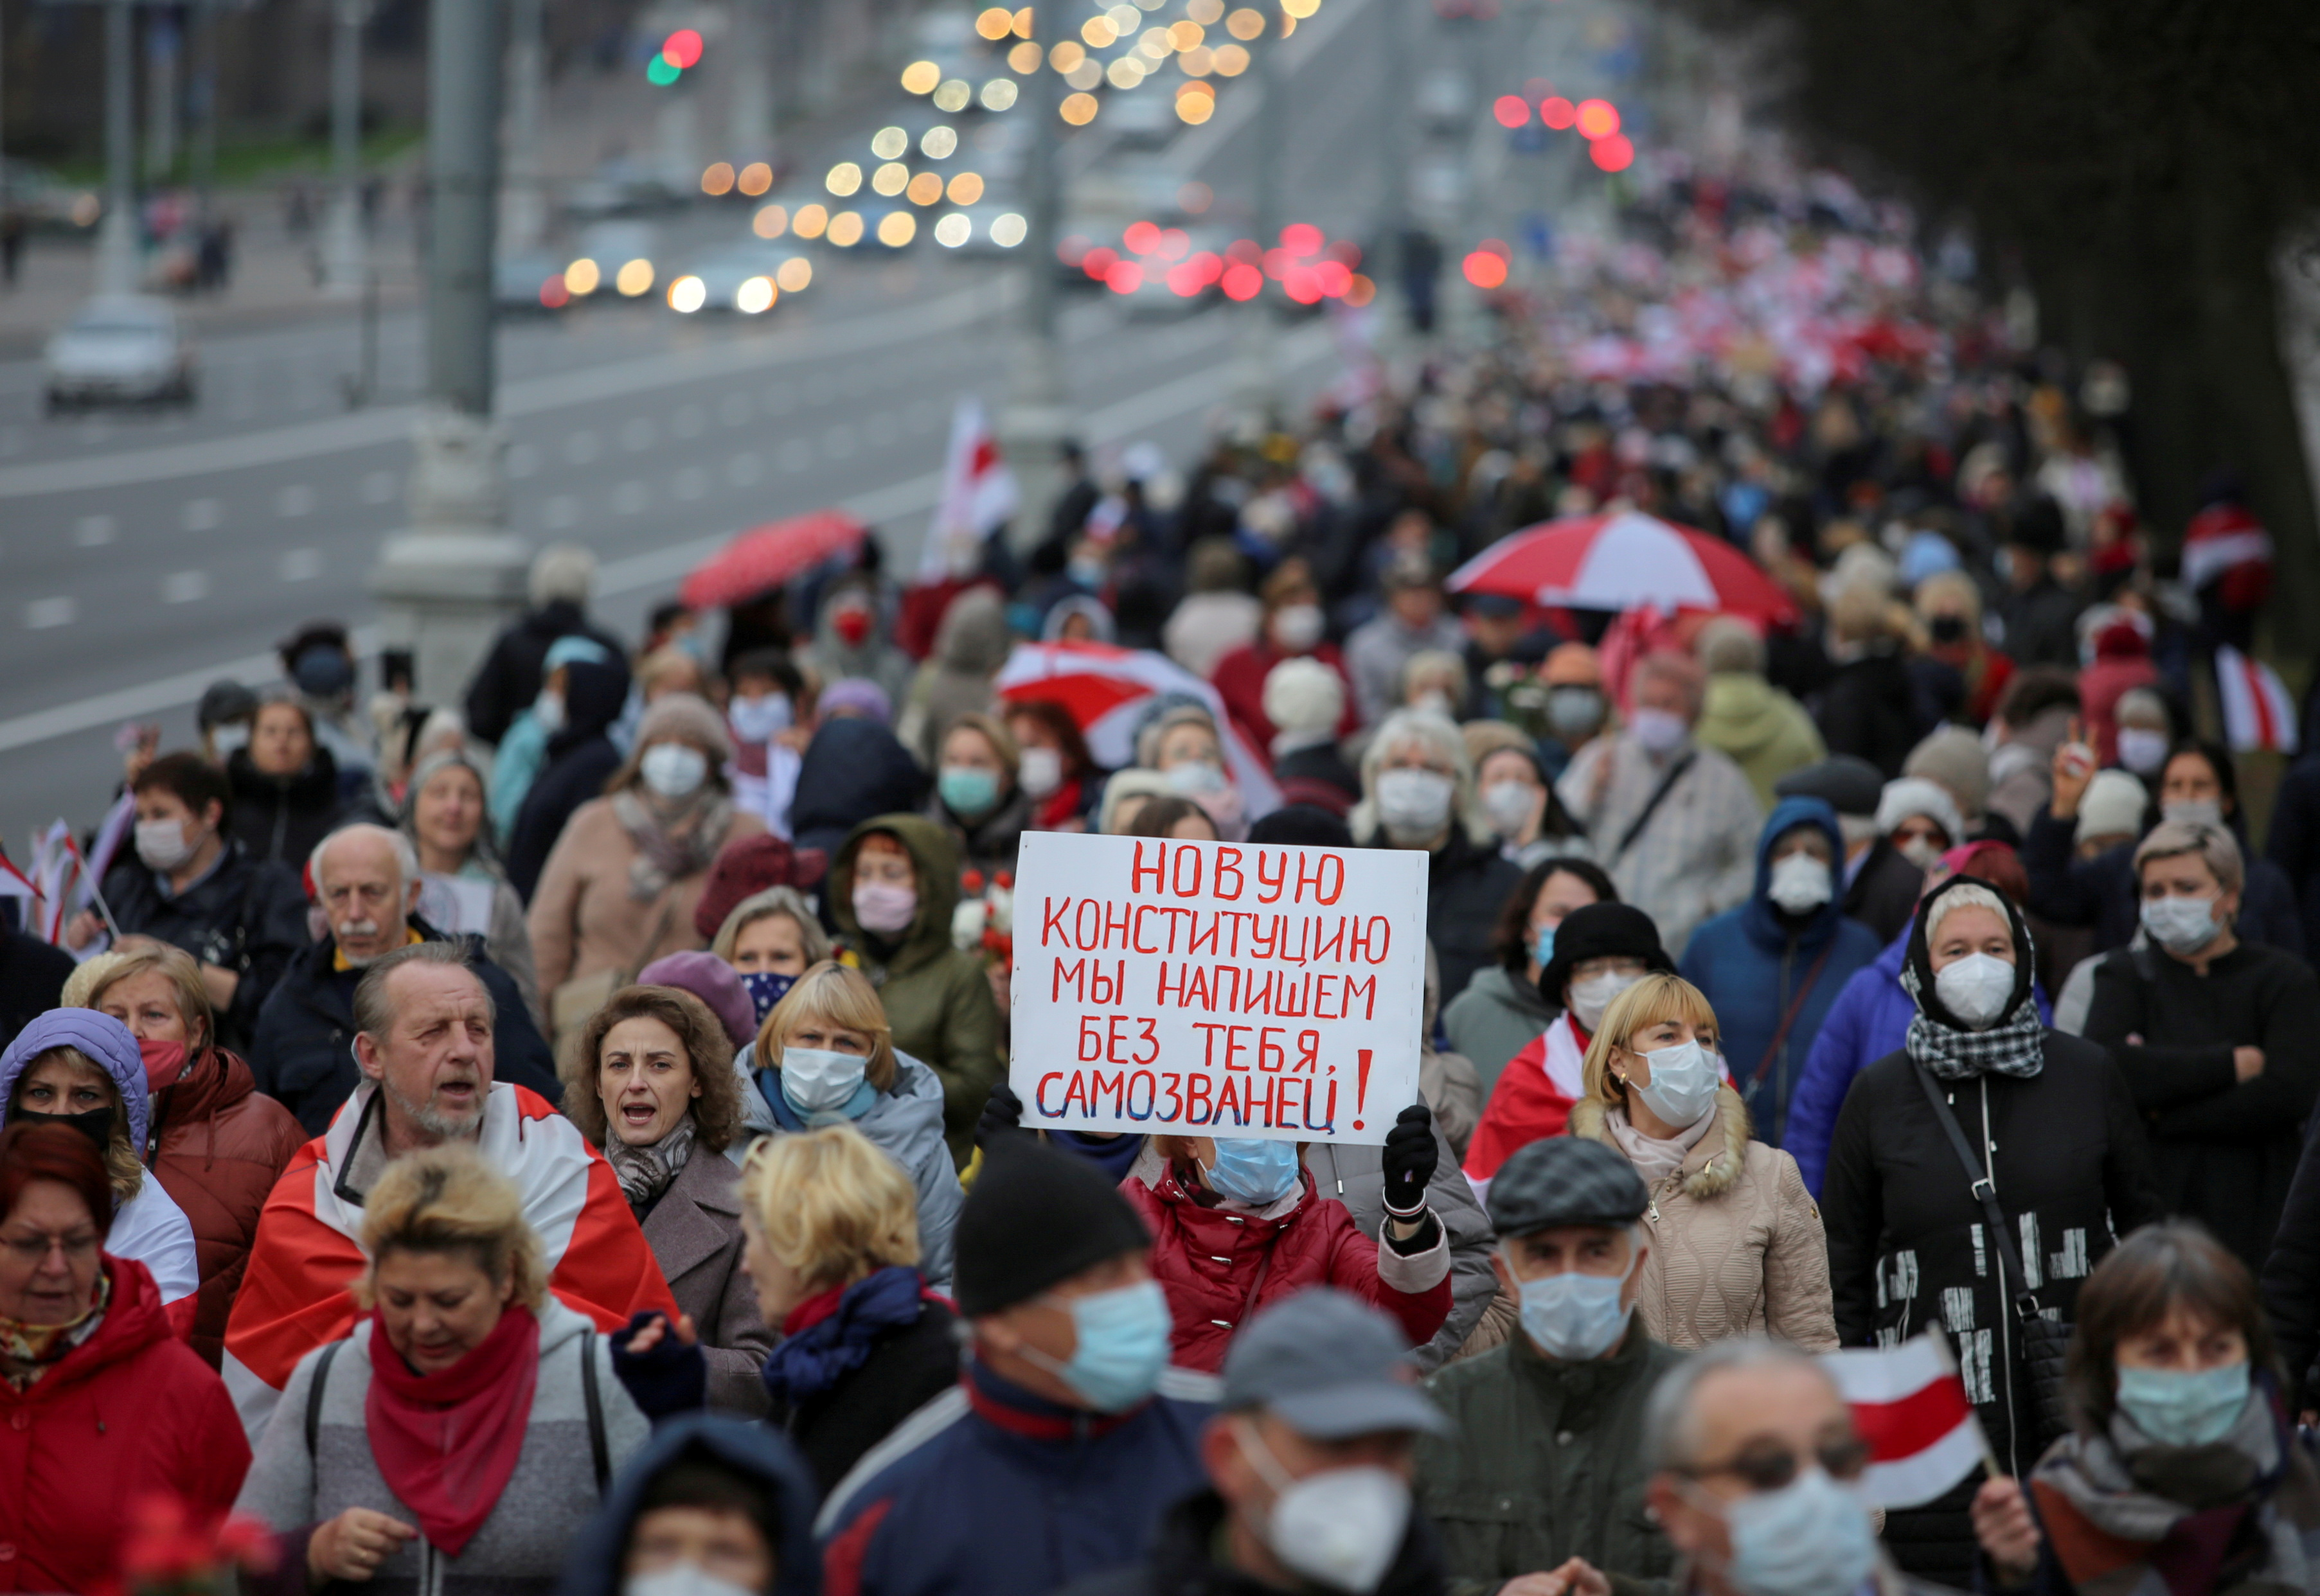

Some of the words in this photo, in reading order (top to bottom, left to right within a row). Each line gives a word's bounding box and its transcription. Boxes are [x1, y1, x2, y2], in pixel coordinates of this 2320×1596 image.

[1132, 841, 1345, 906] НОВУЮ
[1042, 896, 1391, 967] КОНСТИТУЦИЮ
[1052, 957, 1125, 1006] МЫ
[1157, 961, 1377, 1020] НАПИШЕМ
[1078, 1015, 1160, 1065] БЕЗ
[1192, 1022, 1337, 1077] ТЕБЯ,
